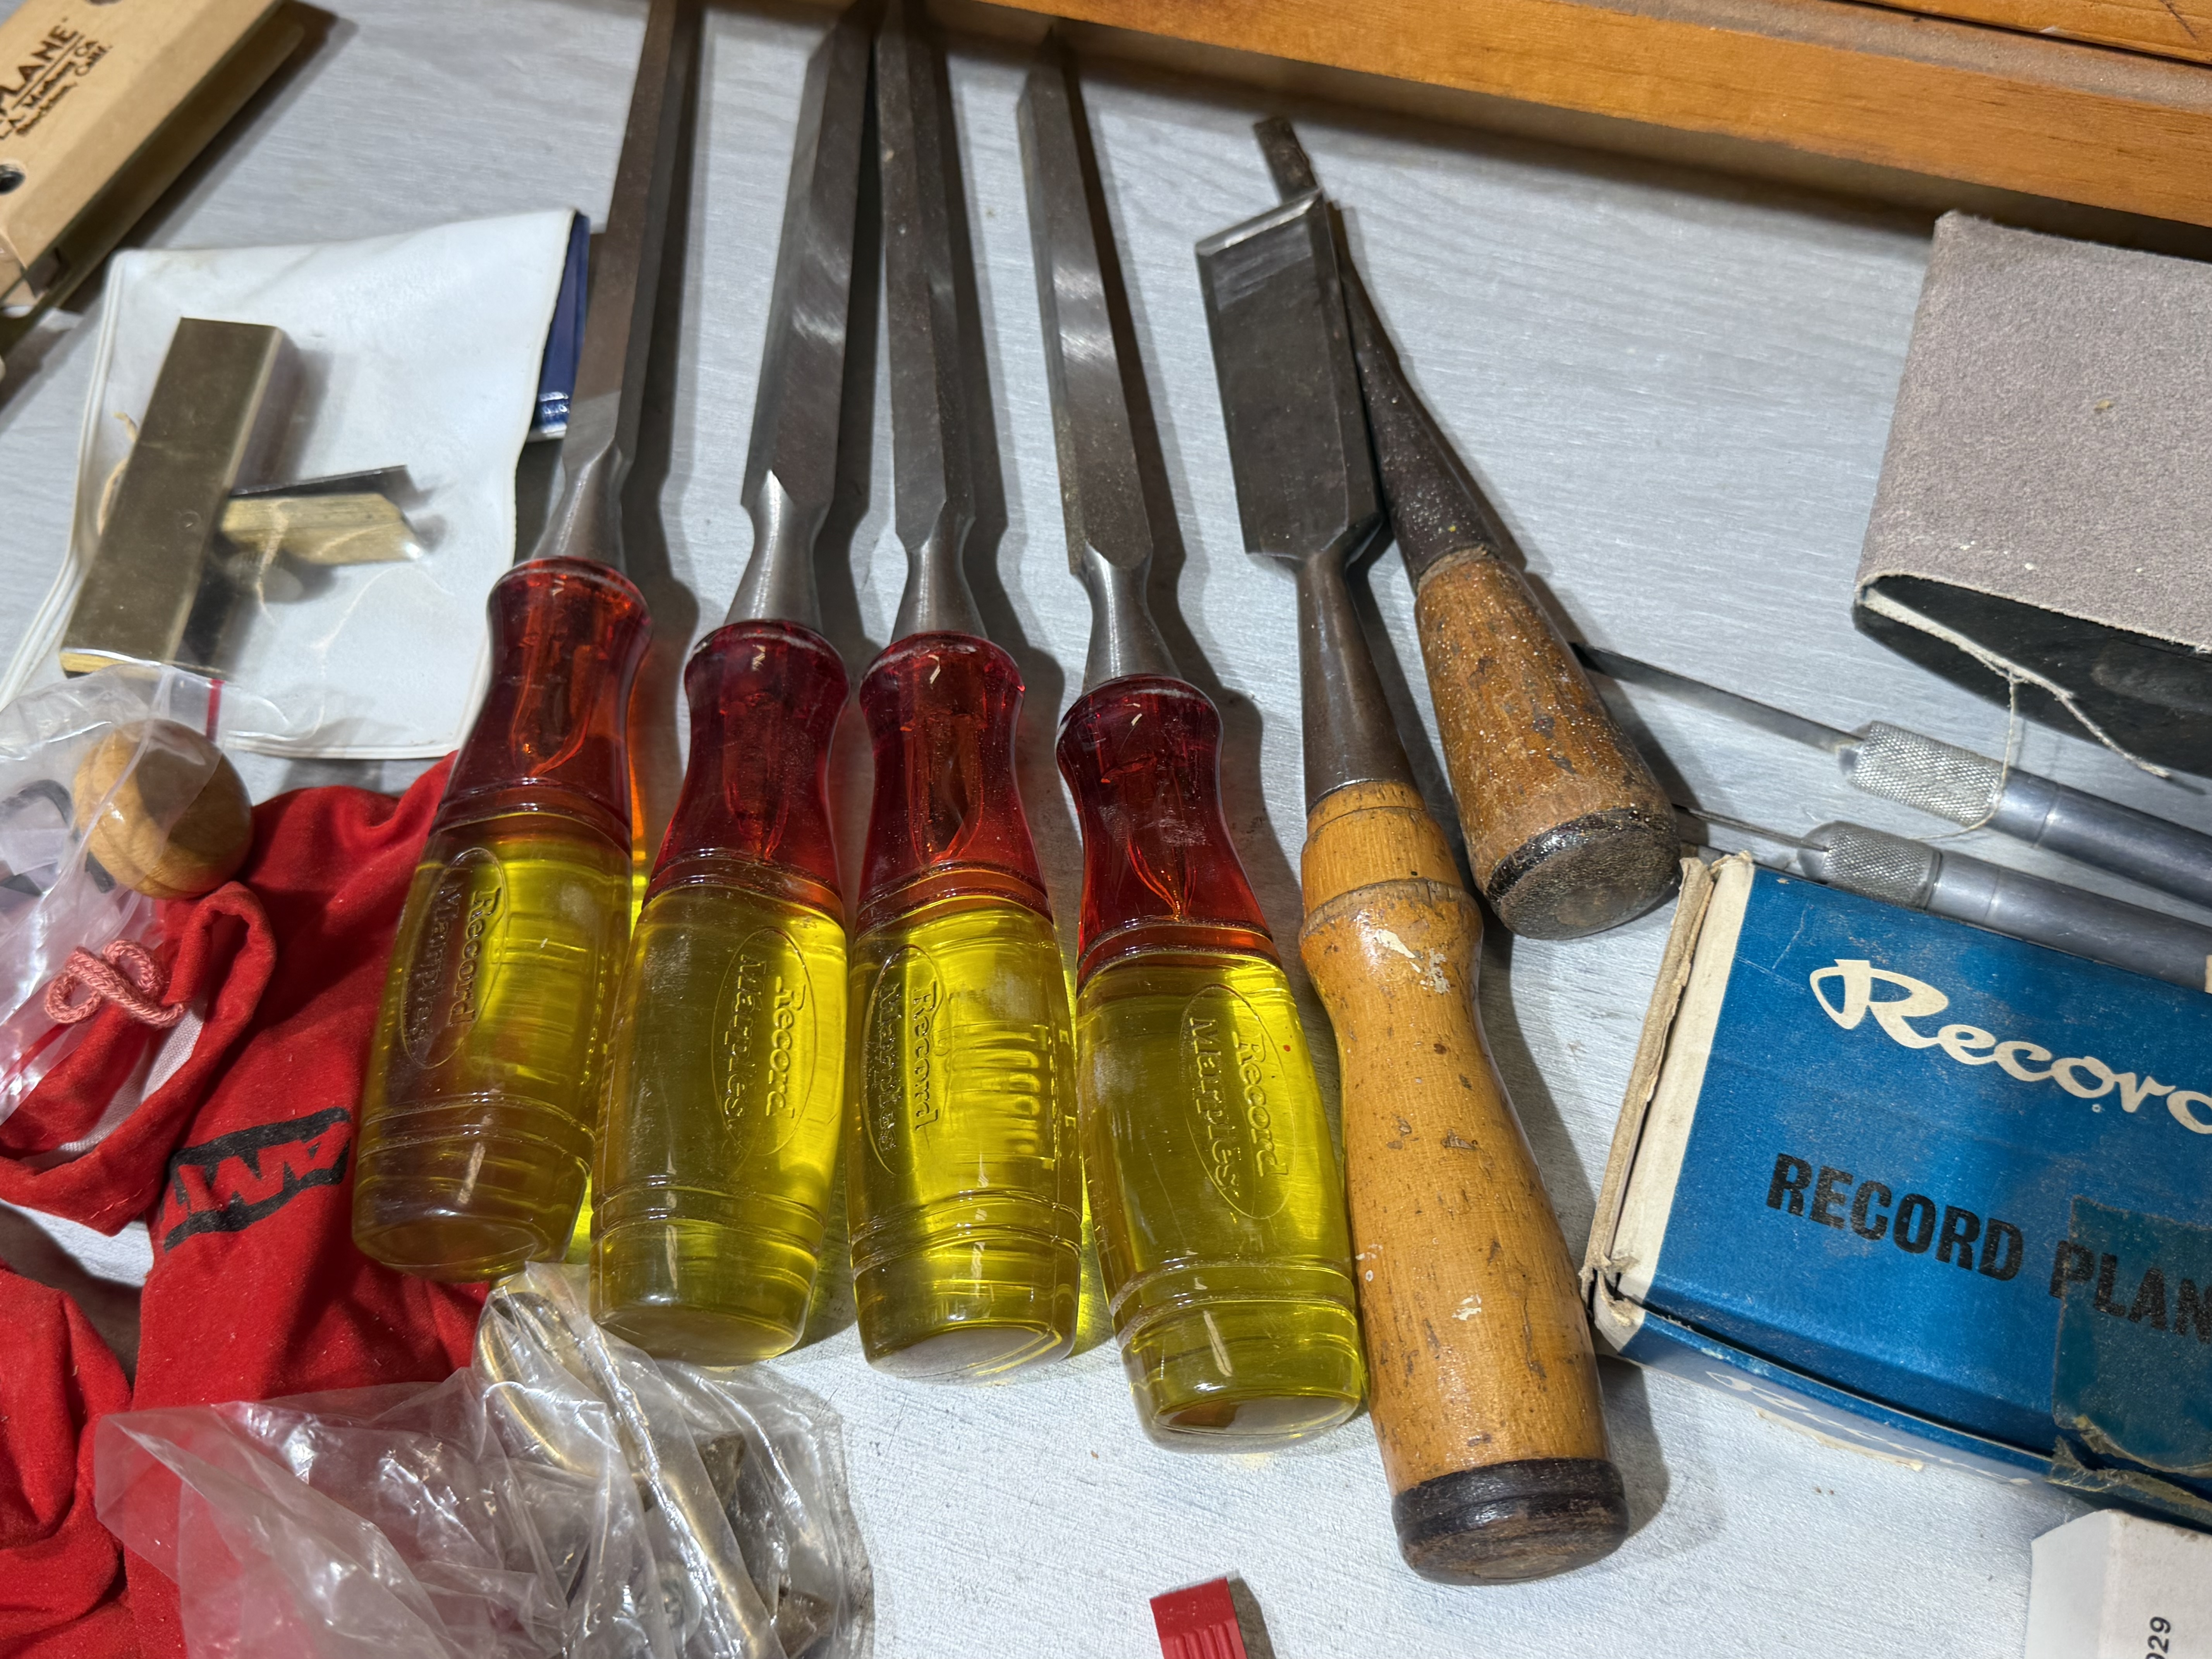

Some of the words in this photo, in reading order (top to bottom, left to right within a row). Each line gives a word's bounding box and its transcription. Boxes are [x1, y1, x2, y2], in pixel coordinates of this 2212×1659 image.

[0, 25, 78, 116] LANE
[407, 883, 464, 1042] Marples
[449, 888, 501, 1027] Record
[724, 954, 767, 1117] Marples
[766, 976, 806, 1118] Record
[913, 977, 939, 1131] Record
[1189, 1017, 1238, 1187] Marples
[1232, 1031, 1289, 1177] Record
[1765, 1152, 2024, 1281] RECORD
